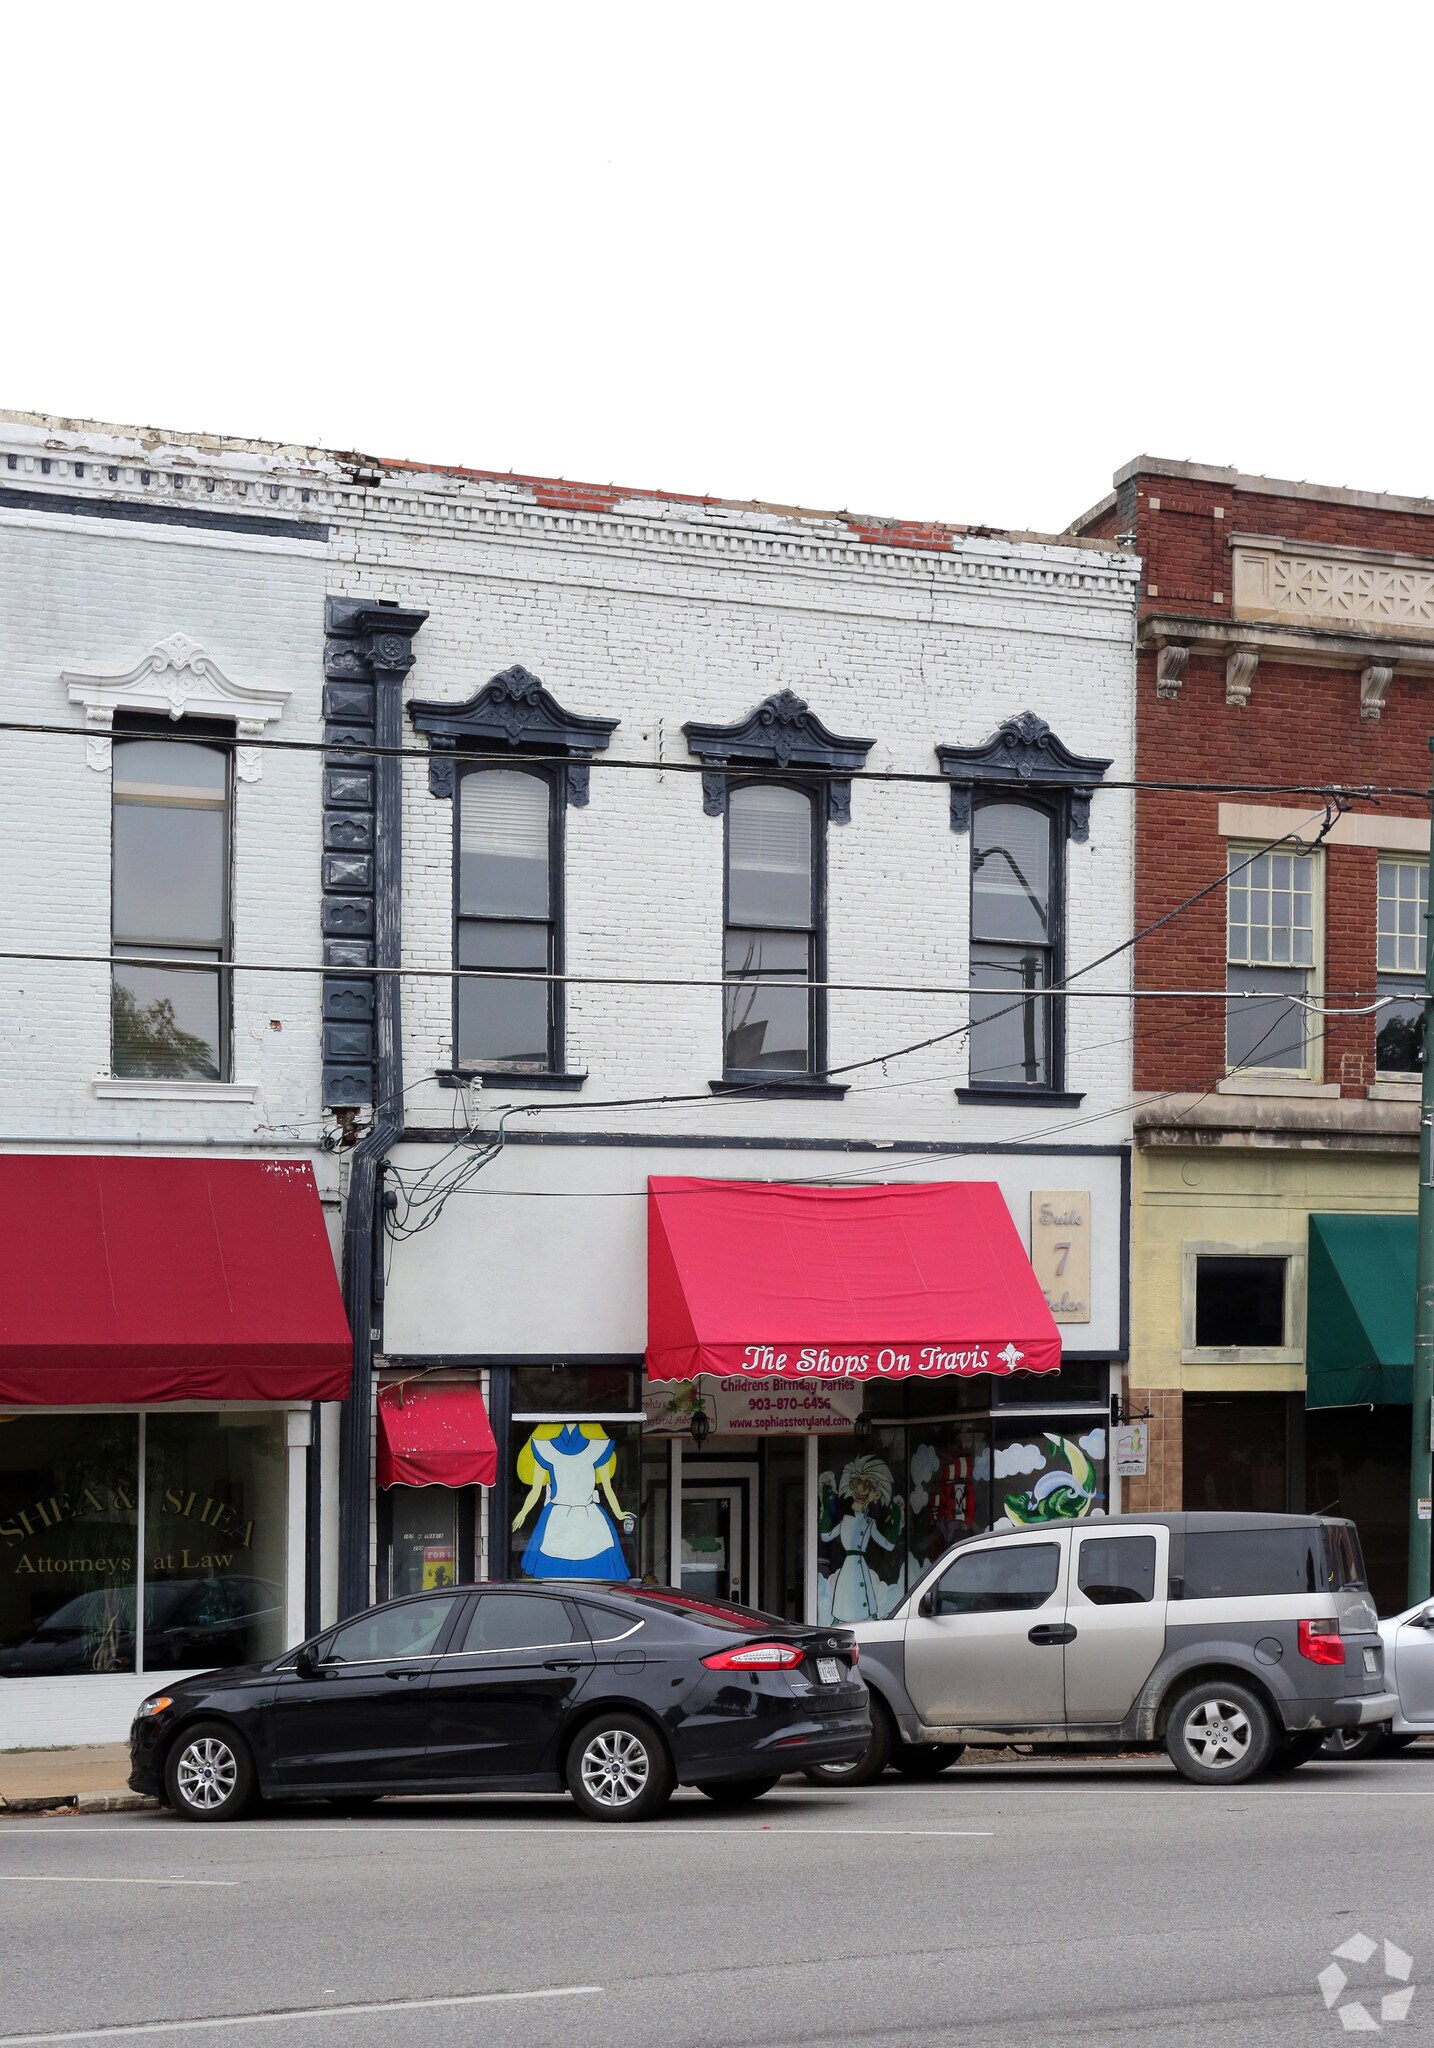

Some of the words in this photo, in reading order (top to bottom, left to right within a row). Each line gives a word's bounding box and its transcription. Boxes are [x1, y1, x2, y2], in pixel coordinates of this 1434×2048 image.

[1039, 1202, 1083, 1226] Suite
[1054, 1241, 1072, 1277] 7
[741, 1345, 788, 1371] The
[795, 1348, 870, 1377] Shops
[876, 1348, 911, 1373] On
[918, 1344, 990, 1371] Travis
[720, 1379, 769, 1393] Childrens
[772, 1379, 817, 1395] Birthday
[820, 1379, 855, 1391] Parties
[641, 1398, 667, 1409] ophia's
[748, 1397, 831, 1411] 903-870-6456
[729, 1414, 851, 1431] www.sophiasstoryland.com
[0, 1488, 105, 1548] SHEA
[112, 1484, 137, 1511] &
[161, 1488, 255, 1549] SHEA
[15, 1553, 131, 1575] Attorneys
[153, 1553, 175, 1570] at
[181, 1548, 233, 1568] Law
